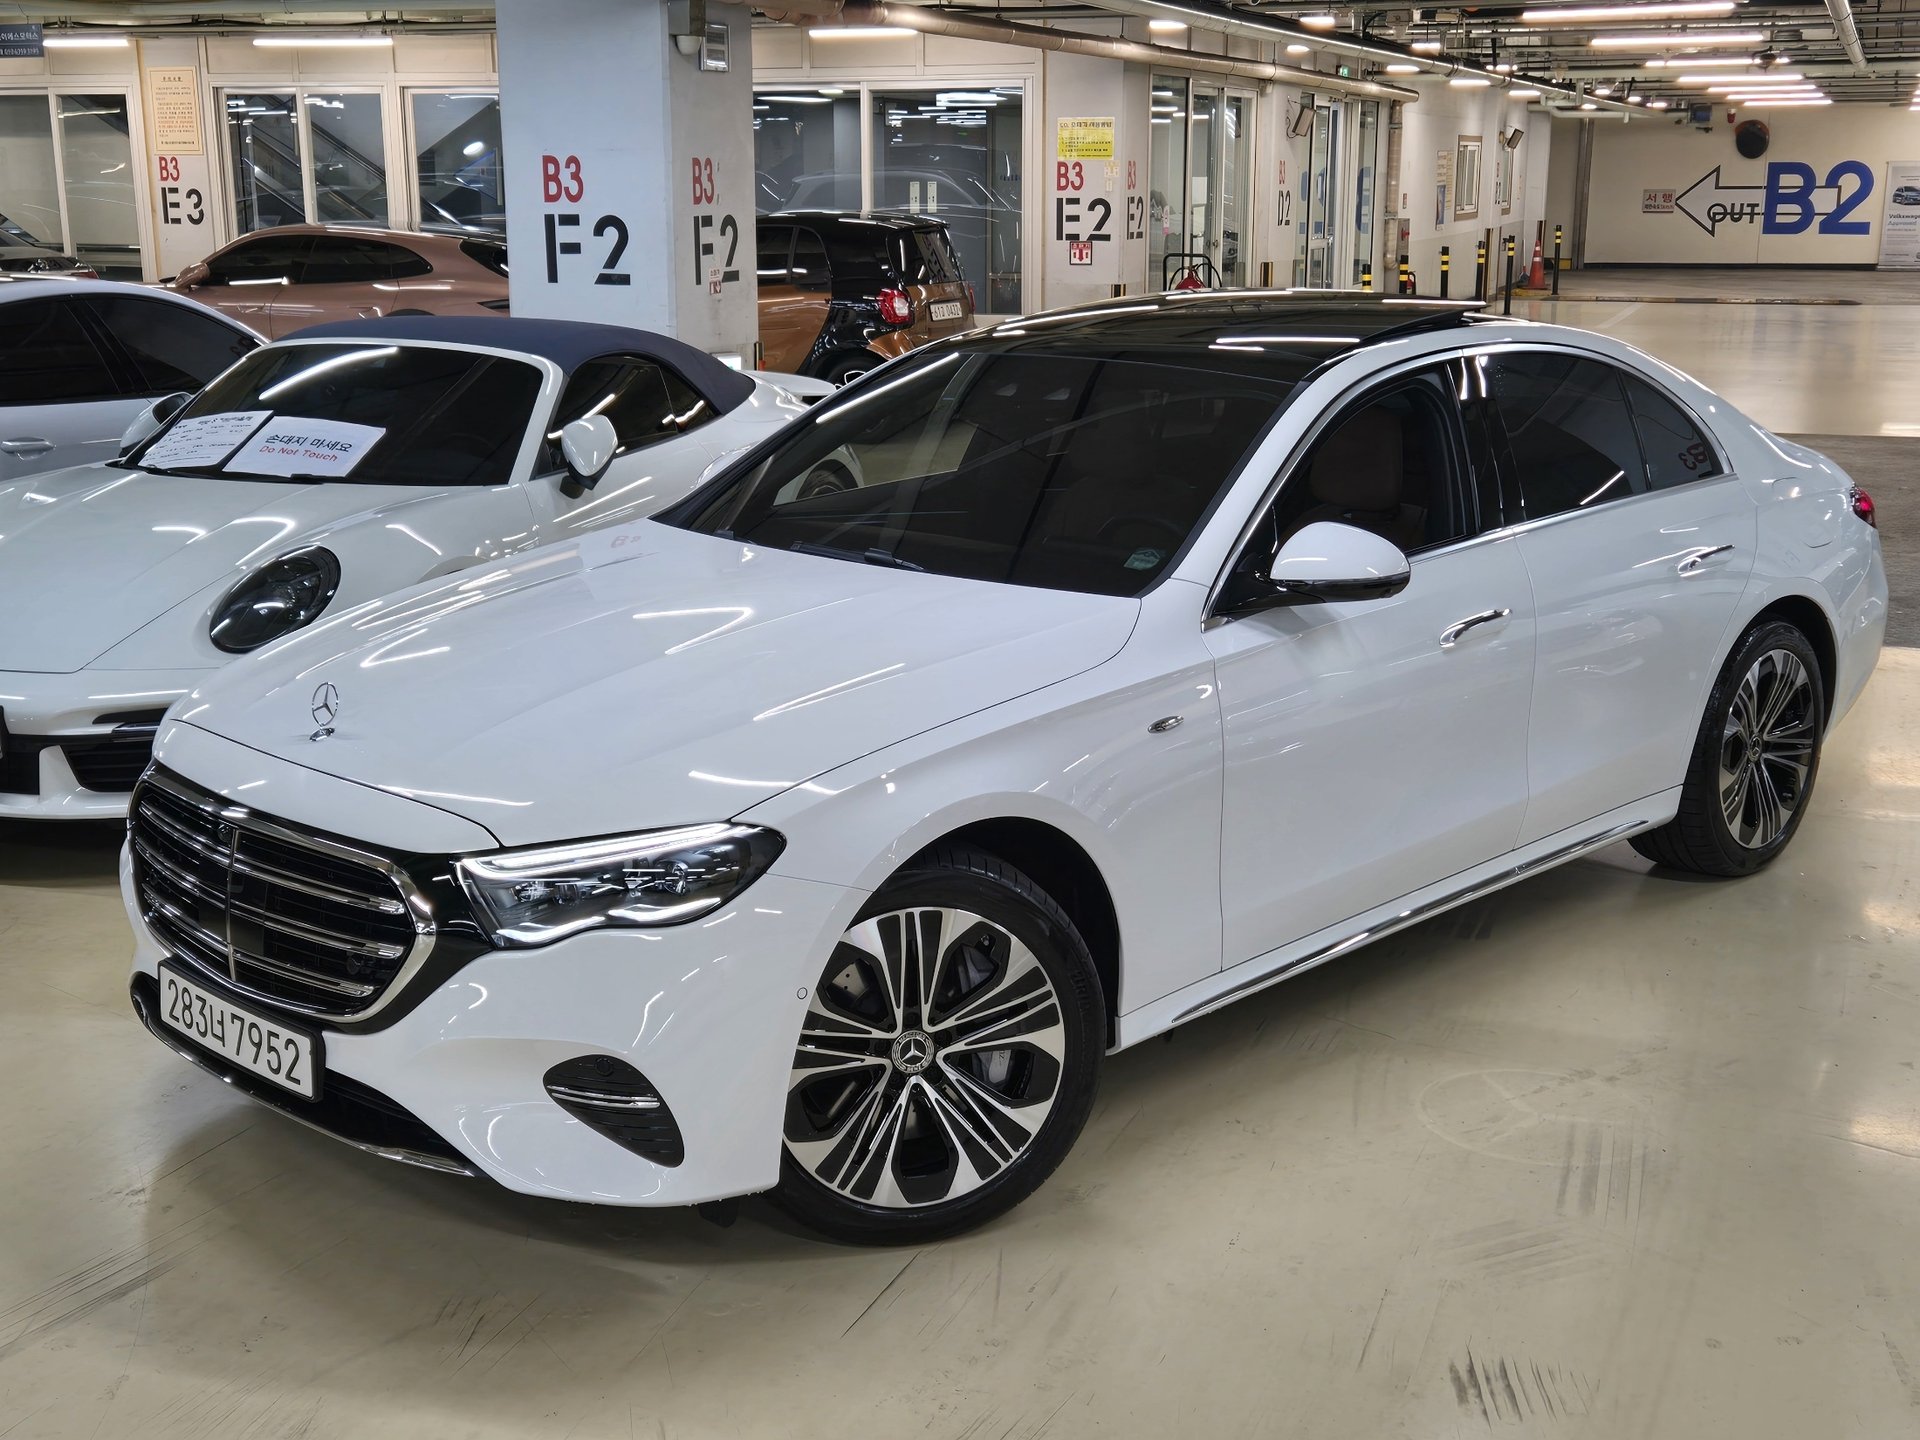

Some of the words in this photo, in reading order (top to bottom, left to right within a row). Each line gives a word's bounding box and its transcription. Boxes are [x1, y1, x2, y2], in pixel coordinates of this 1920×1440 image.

[159, 156, 180, 182] B3
[542, 155, 584, 203] B3
[692, 157, 715, 205] B3
[1056, 161, 1084, 191] B3
[1128, 160, 1137, 190] B3
[161, 187, 204, 225] E3
[1127, 196, 1144, 240] E2
[1277, 190, 1290, 226] D2
[1706, 203, 1760, 224] OUT
[1762, 160, 1874, 235] B2
[1056, 197, 1112, 241] E2
[544, 214, 631, 285] F2
[693, 214, 740, 285] F2
[259, 445, 276, 454] Do
[278, 446, 299, 456] Not
[302, 448, 338, 462] Touch
[265, 434, 308, 446] 손대지
[310, 438, 352, 453] 마세요
[168, 978, 226, 1048] 283너
[230, 1012, 301, 1086] 7952
